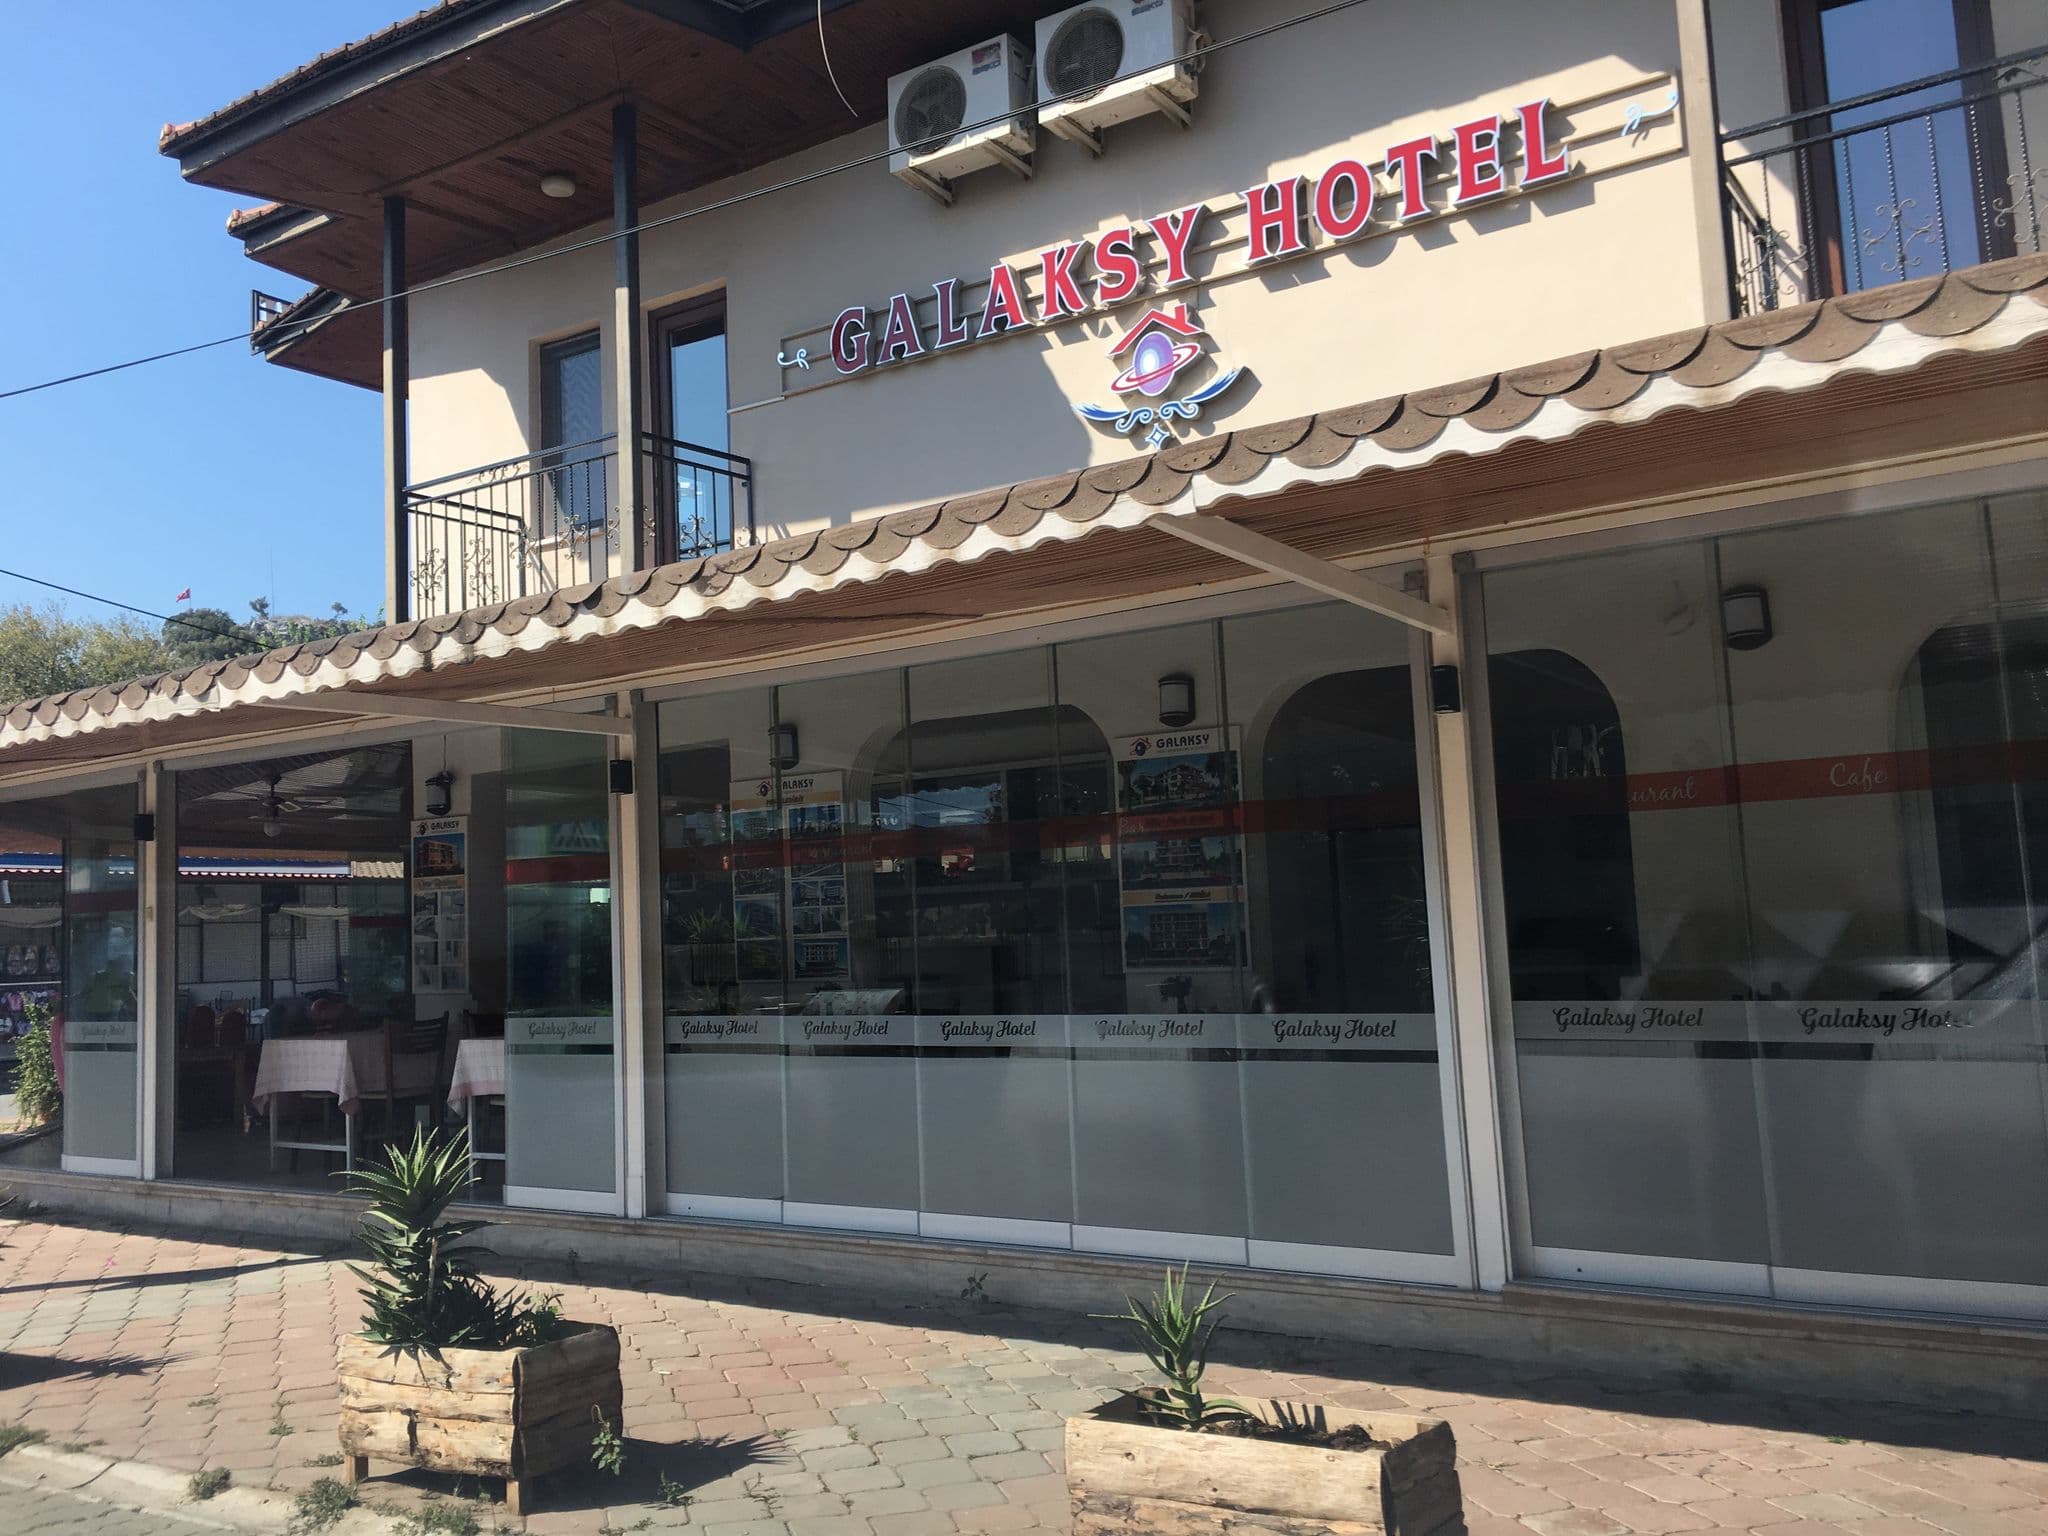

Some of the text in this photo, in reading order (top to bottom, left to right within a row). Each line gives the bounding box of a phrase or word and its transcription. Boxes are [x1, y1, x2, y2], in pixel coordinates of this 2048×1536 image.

[829, 97, 1569, 375] GALAKSY HOTEL
[1156, 734, 1210, 748] GALAKSY
[782, 778, 814, 790] ALAKSY
[1830, 757, 1889, 792] Cafe
[528, 1020, 597, 1040] Galaksy Hotel
[681, 1020, 759, 1040] Galaksy Hotel
[803, 1020, 889, 1040] Galaksy Hotel
[940, 1020, 1037, 1042] Galaksy Hotel
[1095, 1019, 1204, 1042] Galaksy Hotel
[1272, 1019, 1397, 1044] Galaksy Hotel
[1552, 1007, 1704, 1034] Galaksy Hotel
[1798, 1007, 1897, 1037] Galaksy
